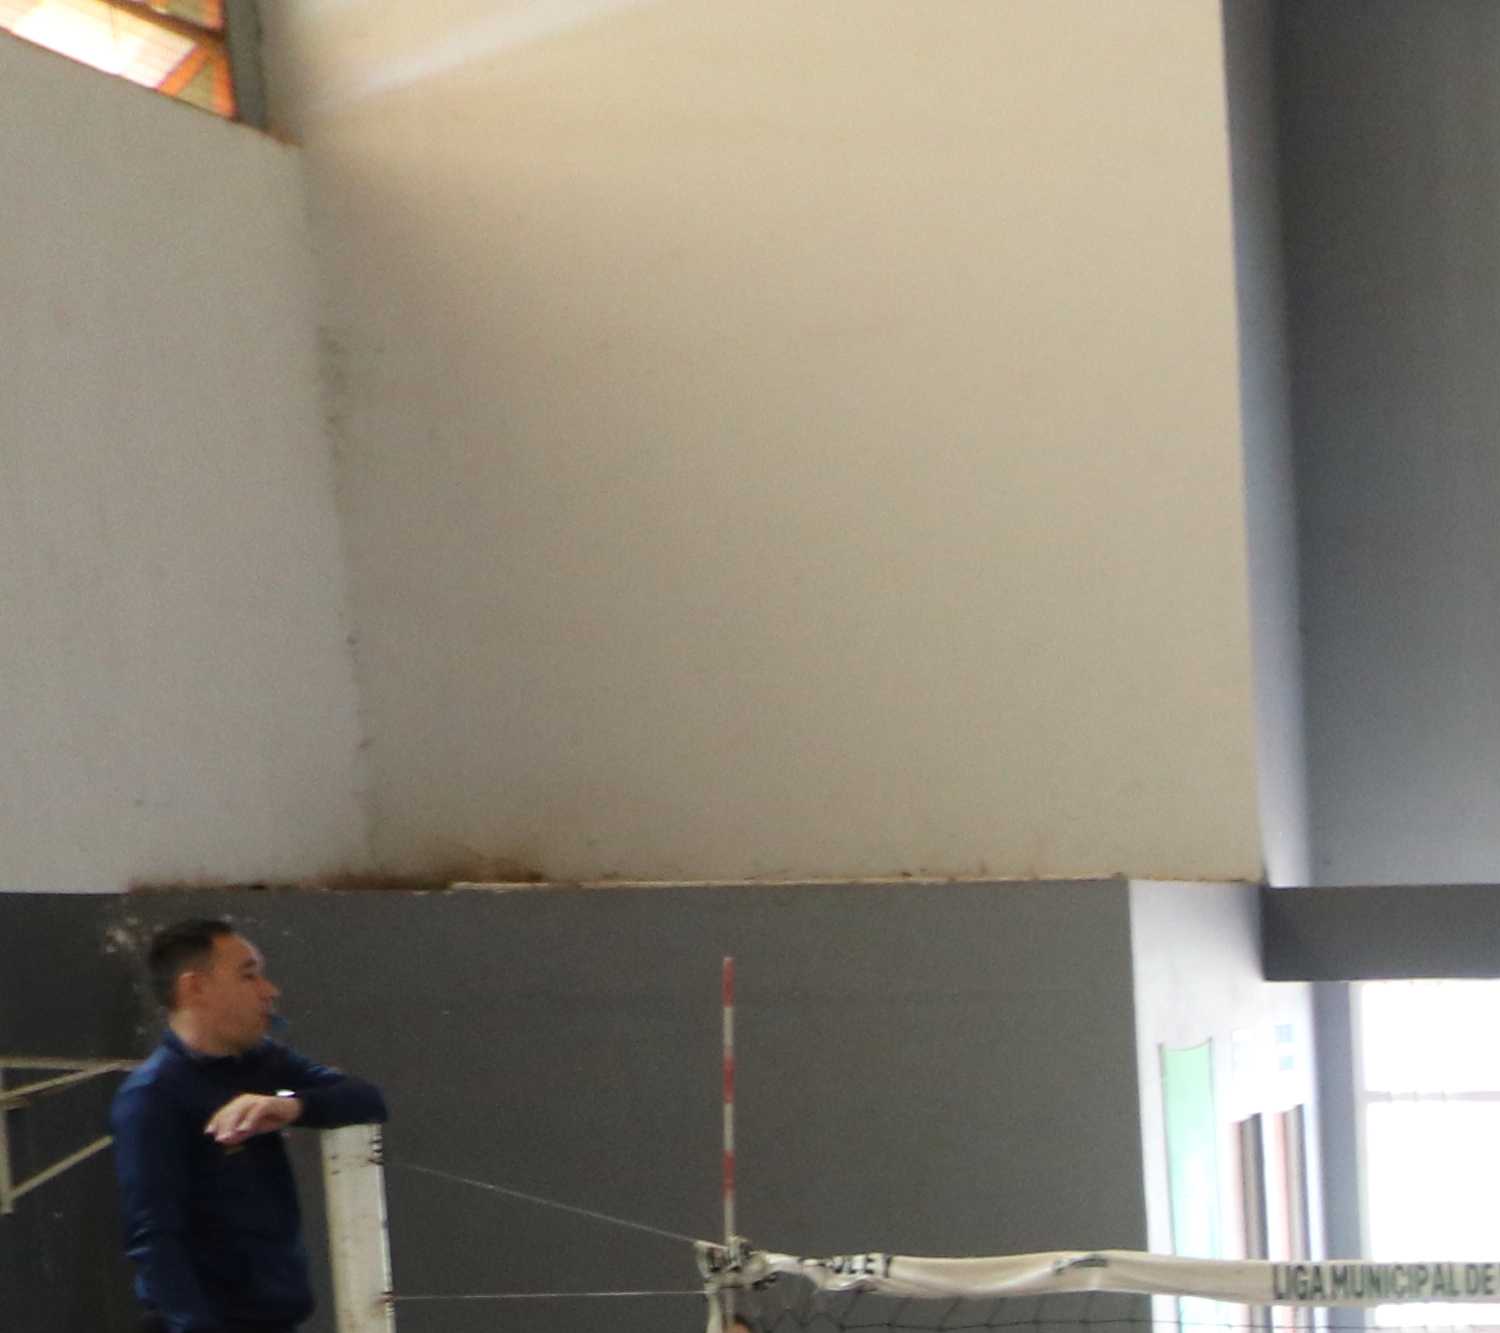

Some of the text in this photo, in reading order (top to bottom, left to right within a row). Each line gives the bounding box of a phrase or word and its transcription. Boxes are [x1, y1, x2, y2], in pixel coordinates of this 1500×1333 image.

[1271, 1264, 1326, 1300] LIGA
[1331, 1262, 1460, 1299] MUNICIPAL
[1465, 1262, 1495, 1295] DE
